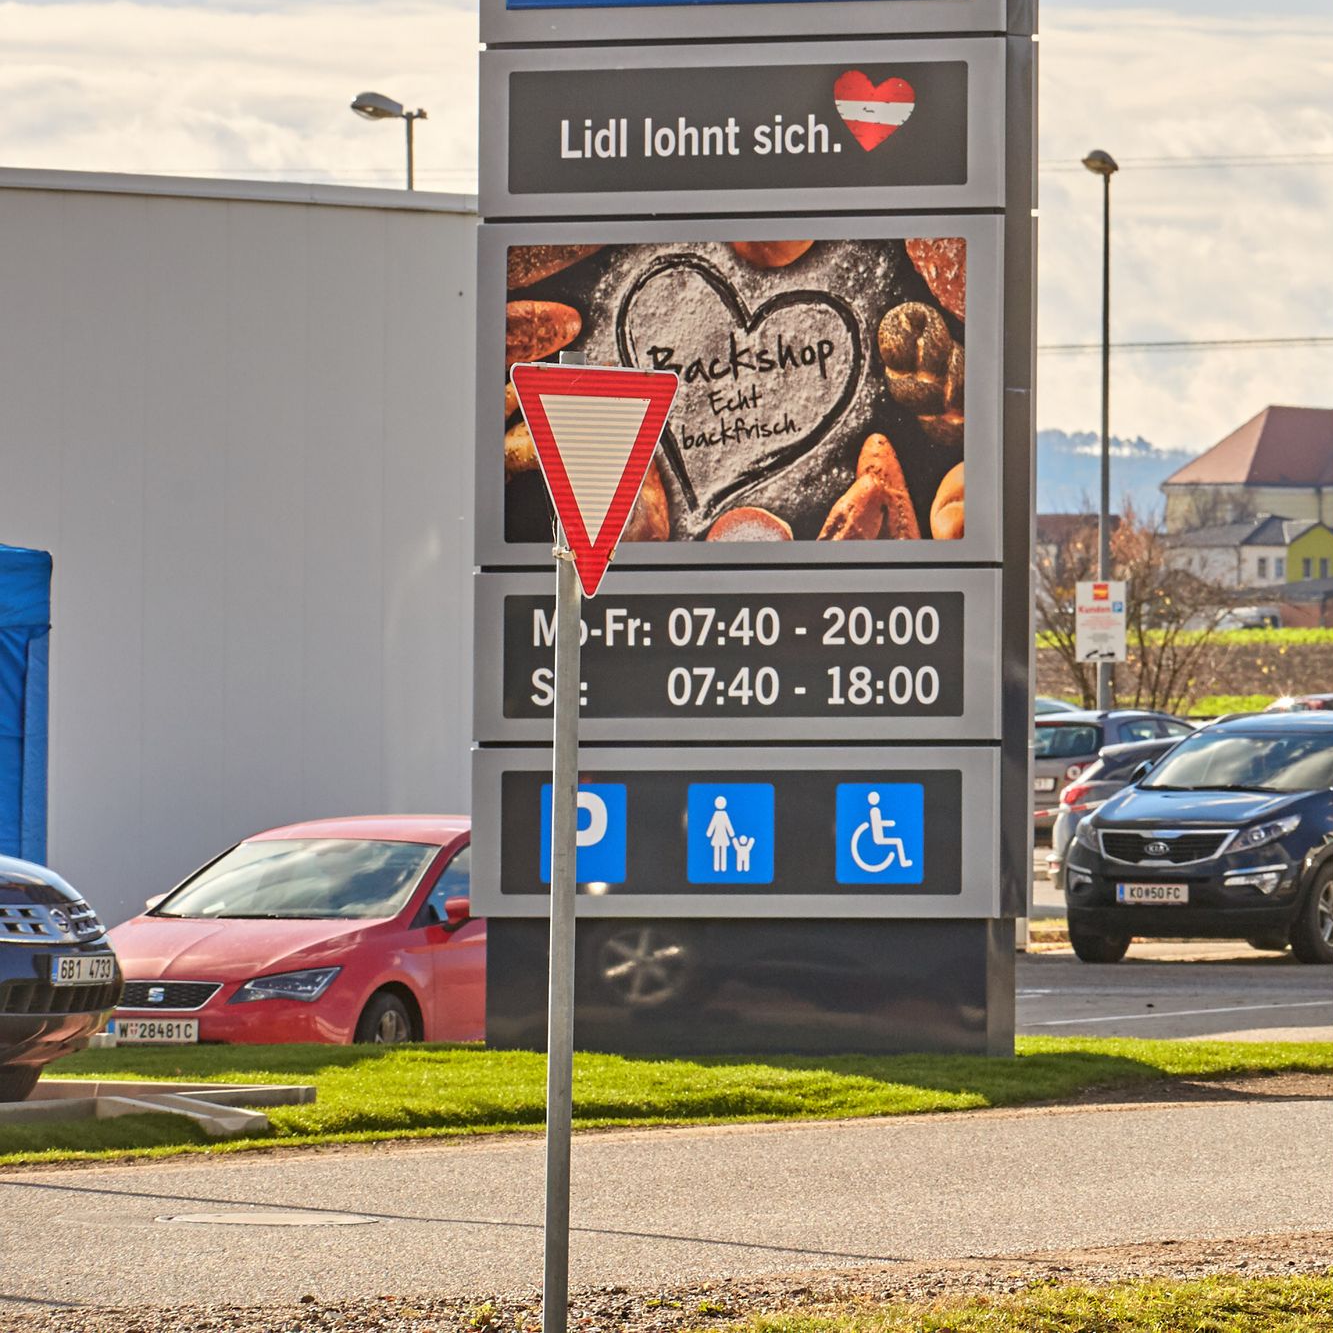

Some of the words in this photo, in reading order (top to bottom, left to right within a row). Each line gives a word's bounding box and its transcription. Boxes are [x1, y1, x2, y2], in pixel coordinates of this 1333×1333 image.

[560, 118, 628, 159] Lidl
[644, 116, 740, 157] lohnt
[753, 113, 843, 155] sich.
[646, 331, 835, 383] Backshop
[707, 384, 763, 416] Echt
[681, 412, 802, 450] backfrisch.
[667, 606, 781, 647] 07:40
[821, 605, 941, 646] 20:00
[530, 666, 589, 707] S:
[667, 665, 781, 706] 07:40
[827, 664, 941, 706] 18:00
[60, 957, 81, 979] 6B1
[89, 958, 111, 978] 4733
